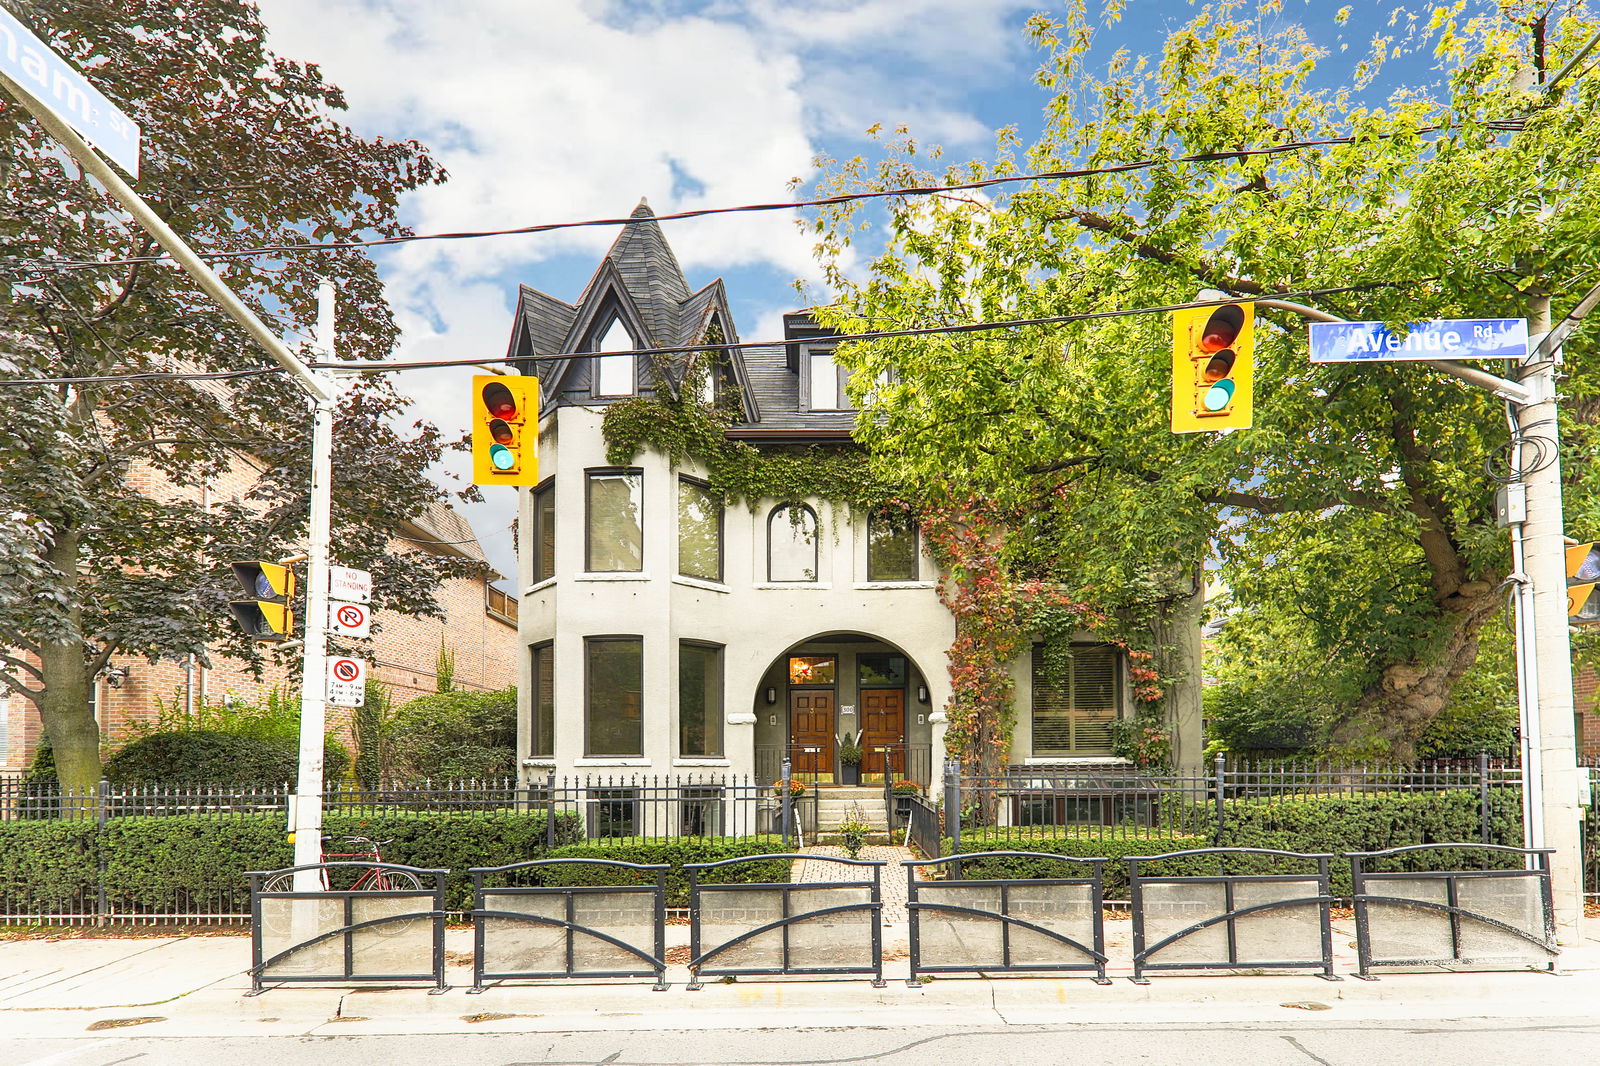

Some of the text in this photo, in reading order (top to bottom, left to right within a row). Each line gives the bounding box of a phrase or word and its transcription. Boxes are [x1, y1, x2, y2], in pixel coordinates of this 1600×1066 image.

[1347, 327, 1461, 352] Avenue
[345, 571, 358, 580] NO
[334, 579, 368, 592] STANDING
